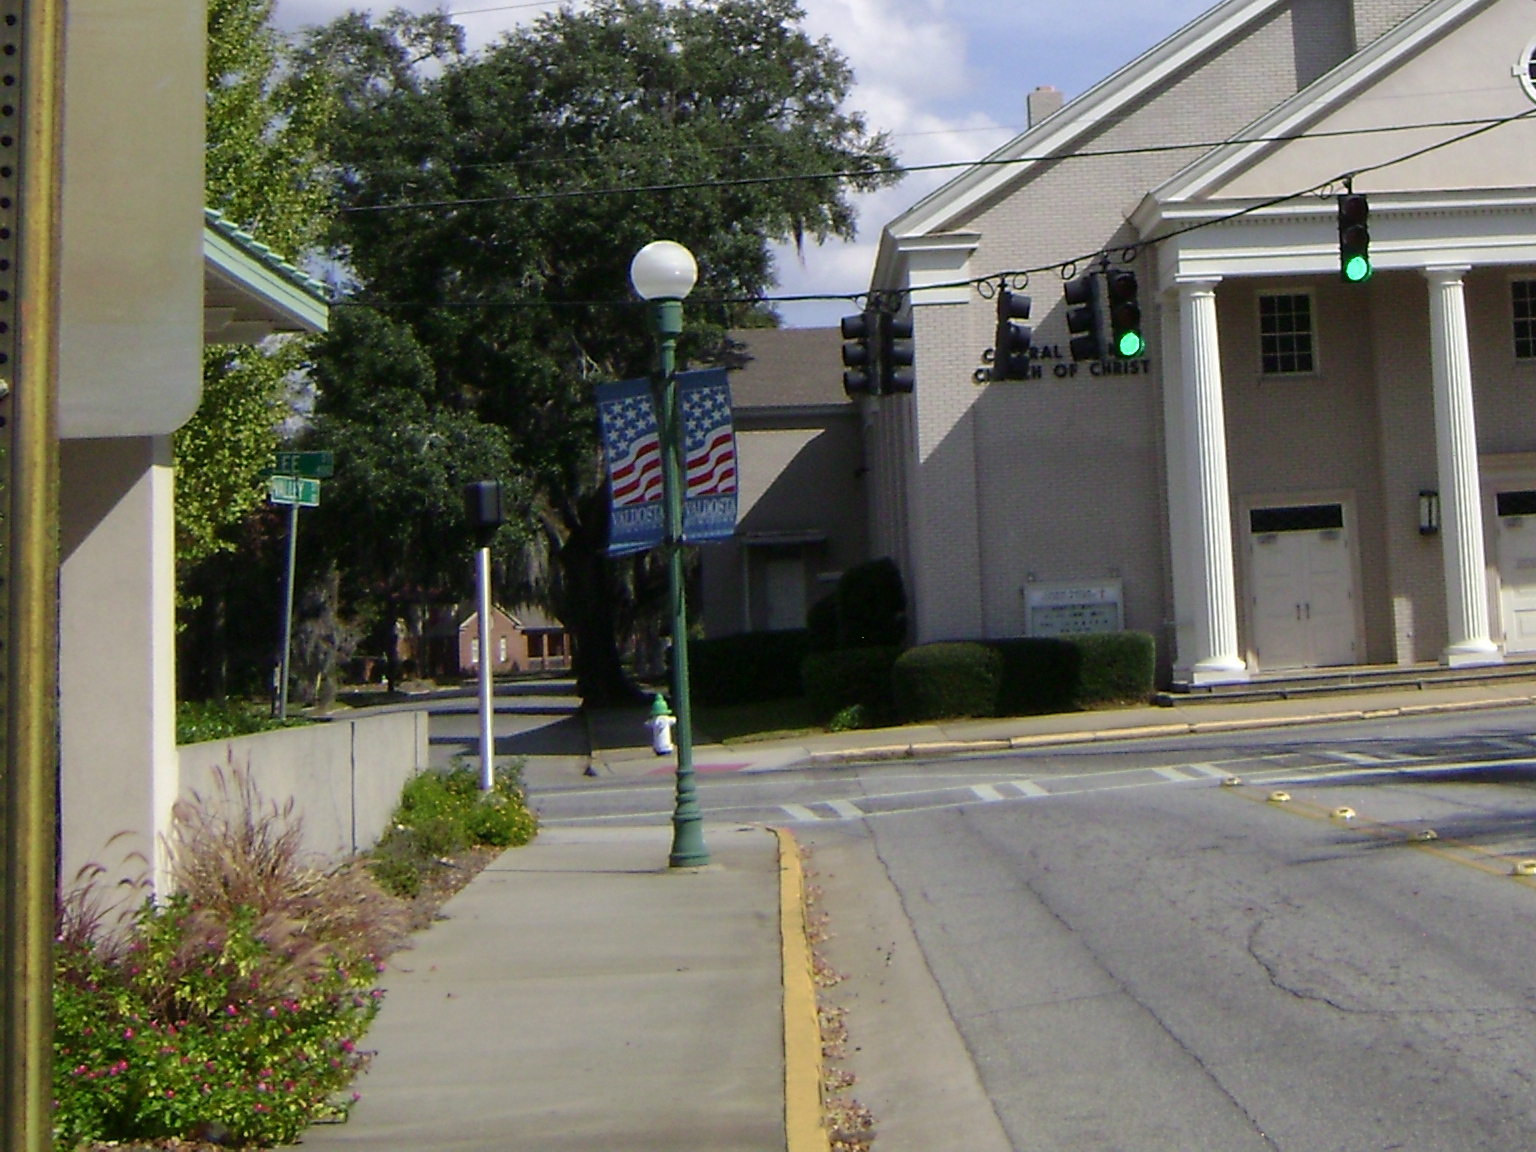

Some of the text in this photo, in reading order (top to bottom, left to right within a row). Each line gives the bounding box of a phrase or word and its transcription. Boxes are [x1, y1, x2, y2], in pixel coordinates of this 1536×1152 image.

[983, 346, 1062, 362] CRAL
[1053, 363, 1077, 378] OF
[1089, 360, 1149, 376] CHRIST
